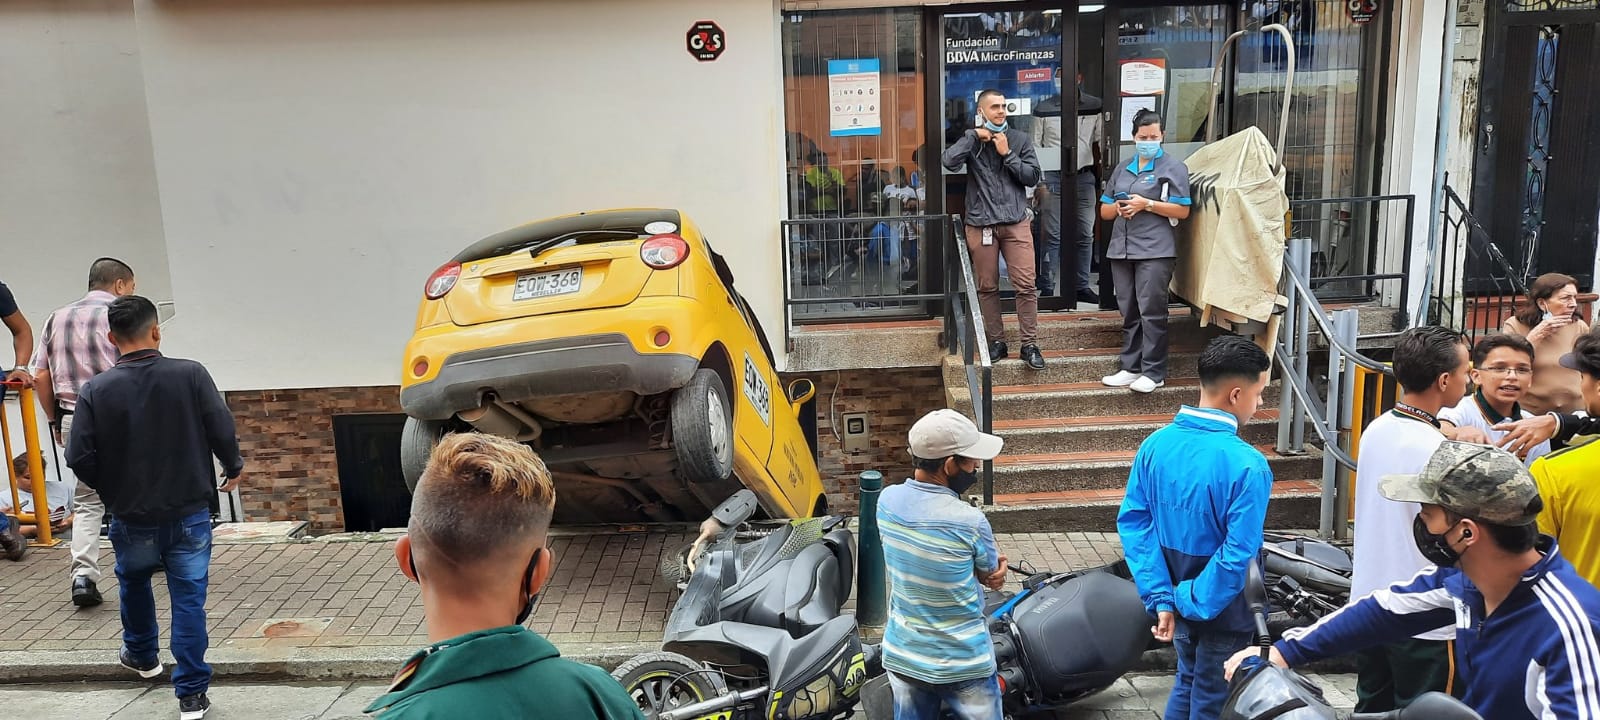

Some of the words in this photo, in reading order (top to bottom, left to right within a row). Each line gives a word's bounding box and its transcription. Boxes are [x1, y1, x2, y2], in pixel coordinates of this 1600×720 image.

[690, 31, 721, 51] G4S
[946, 36, 998, 48] Fundación
[946, 51, 979, 64] BBVA
[981, 50, 1055, 62] MicroFinanzas
